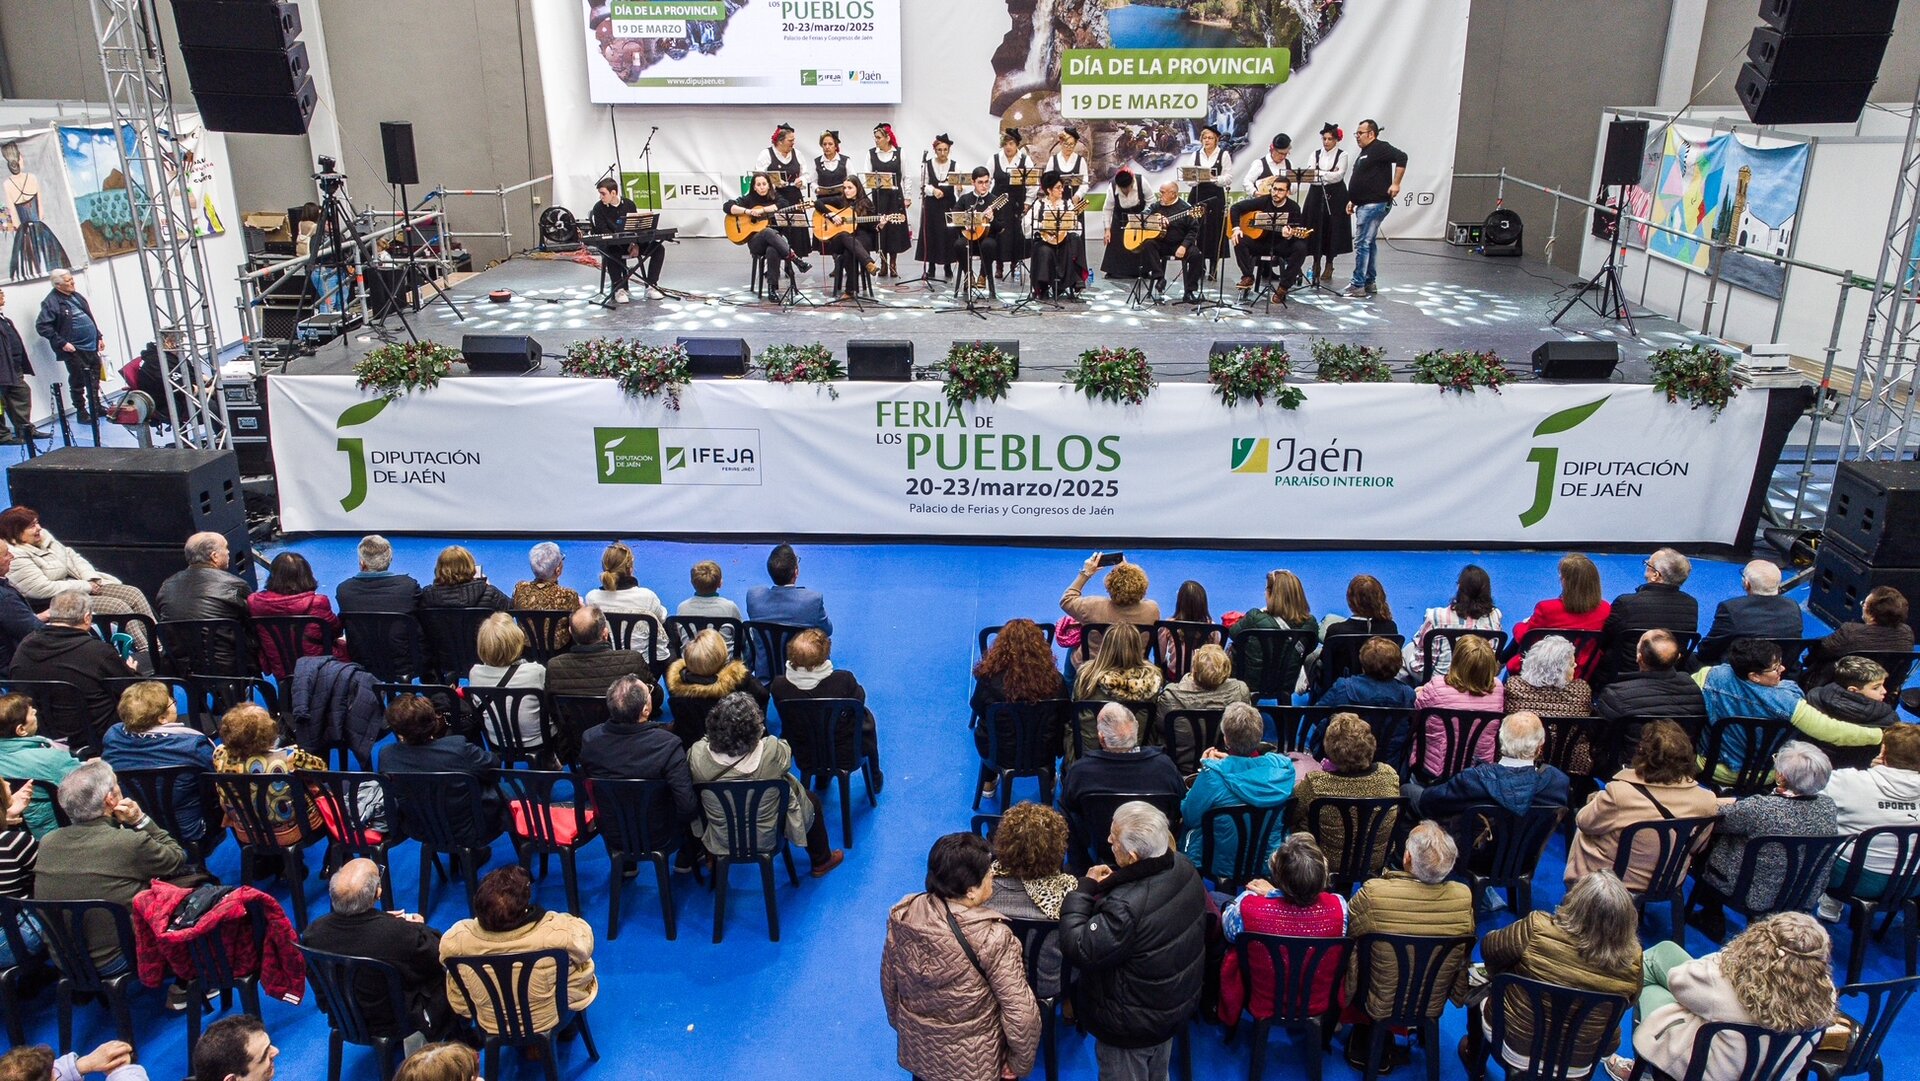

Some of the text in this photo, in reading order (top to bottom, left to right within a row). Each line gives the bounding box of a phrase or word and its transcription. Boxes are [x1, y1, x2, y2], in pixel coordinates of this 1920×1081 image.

[614, 4, 718, 15] DÍA DE LA PROVINCIA
[782, 1, 875, 19] PUEBLOS
[617, 25, 682, 34] 19 DE MARZO
[782, 22, 875, 32] 20-23/marzo/2025
[1070, 55, 1275, 75] DÍA DE LA PROVINCIA
[667, 78, 725, 86] www.dipujaen.es
[859, 71, 882, 80] Jaén
[1071, 93, 1198, 110] 19 DE MARZO
[681, 184, 719, 196] IFEJA
[876, 401, 994, 428] FERIA DE
[371, 450, 481, 465] DIPUTACIÓN
[692, 448, 754, 464] IFEJA
[876, 433, 1121, 472] LOS PUEBLOS
[1275, 438, 1363, 473] Jaén
[1563, 459, 1689, 476] DIPUTACIÓN
[374, 468, 446, 484] DE JAÉN
[1275, 473, 1394, 487] PARAÍSO INTERIOR
[906, 477, 1119, 498] 20-23/marzo/2025
[1560, 481, 1643, 497] DE JAÉN
[909, 503, 1115, 517] Palacio de Ferias y Congresos de Jaén
[1878, 801, 1916, 810] SPORTS
